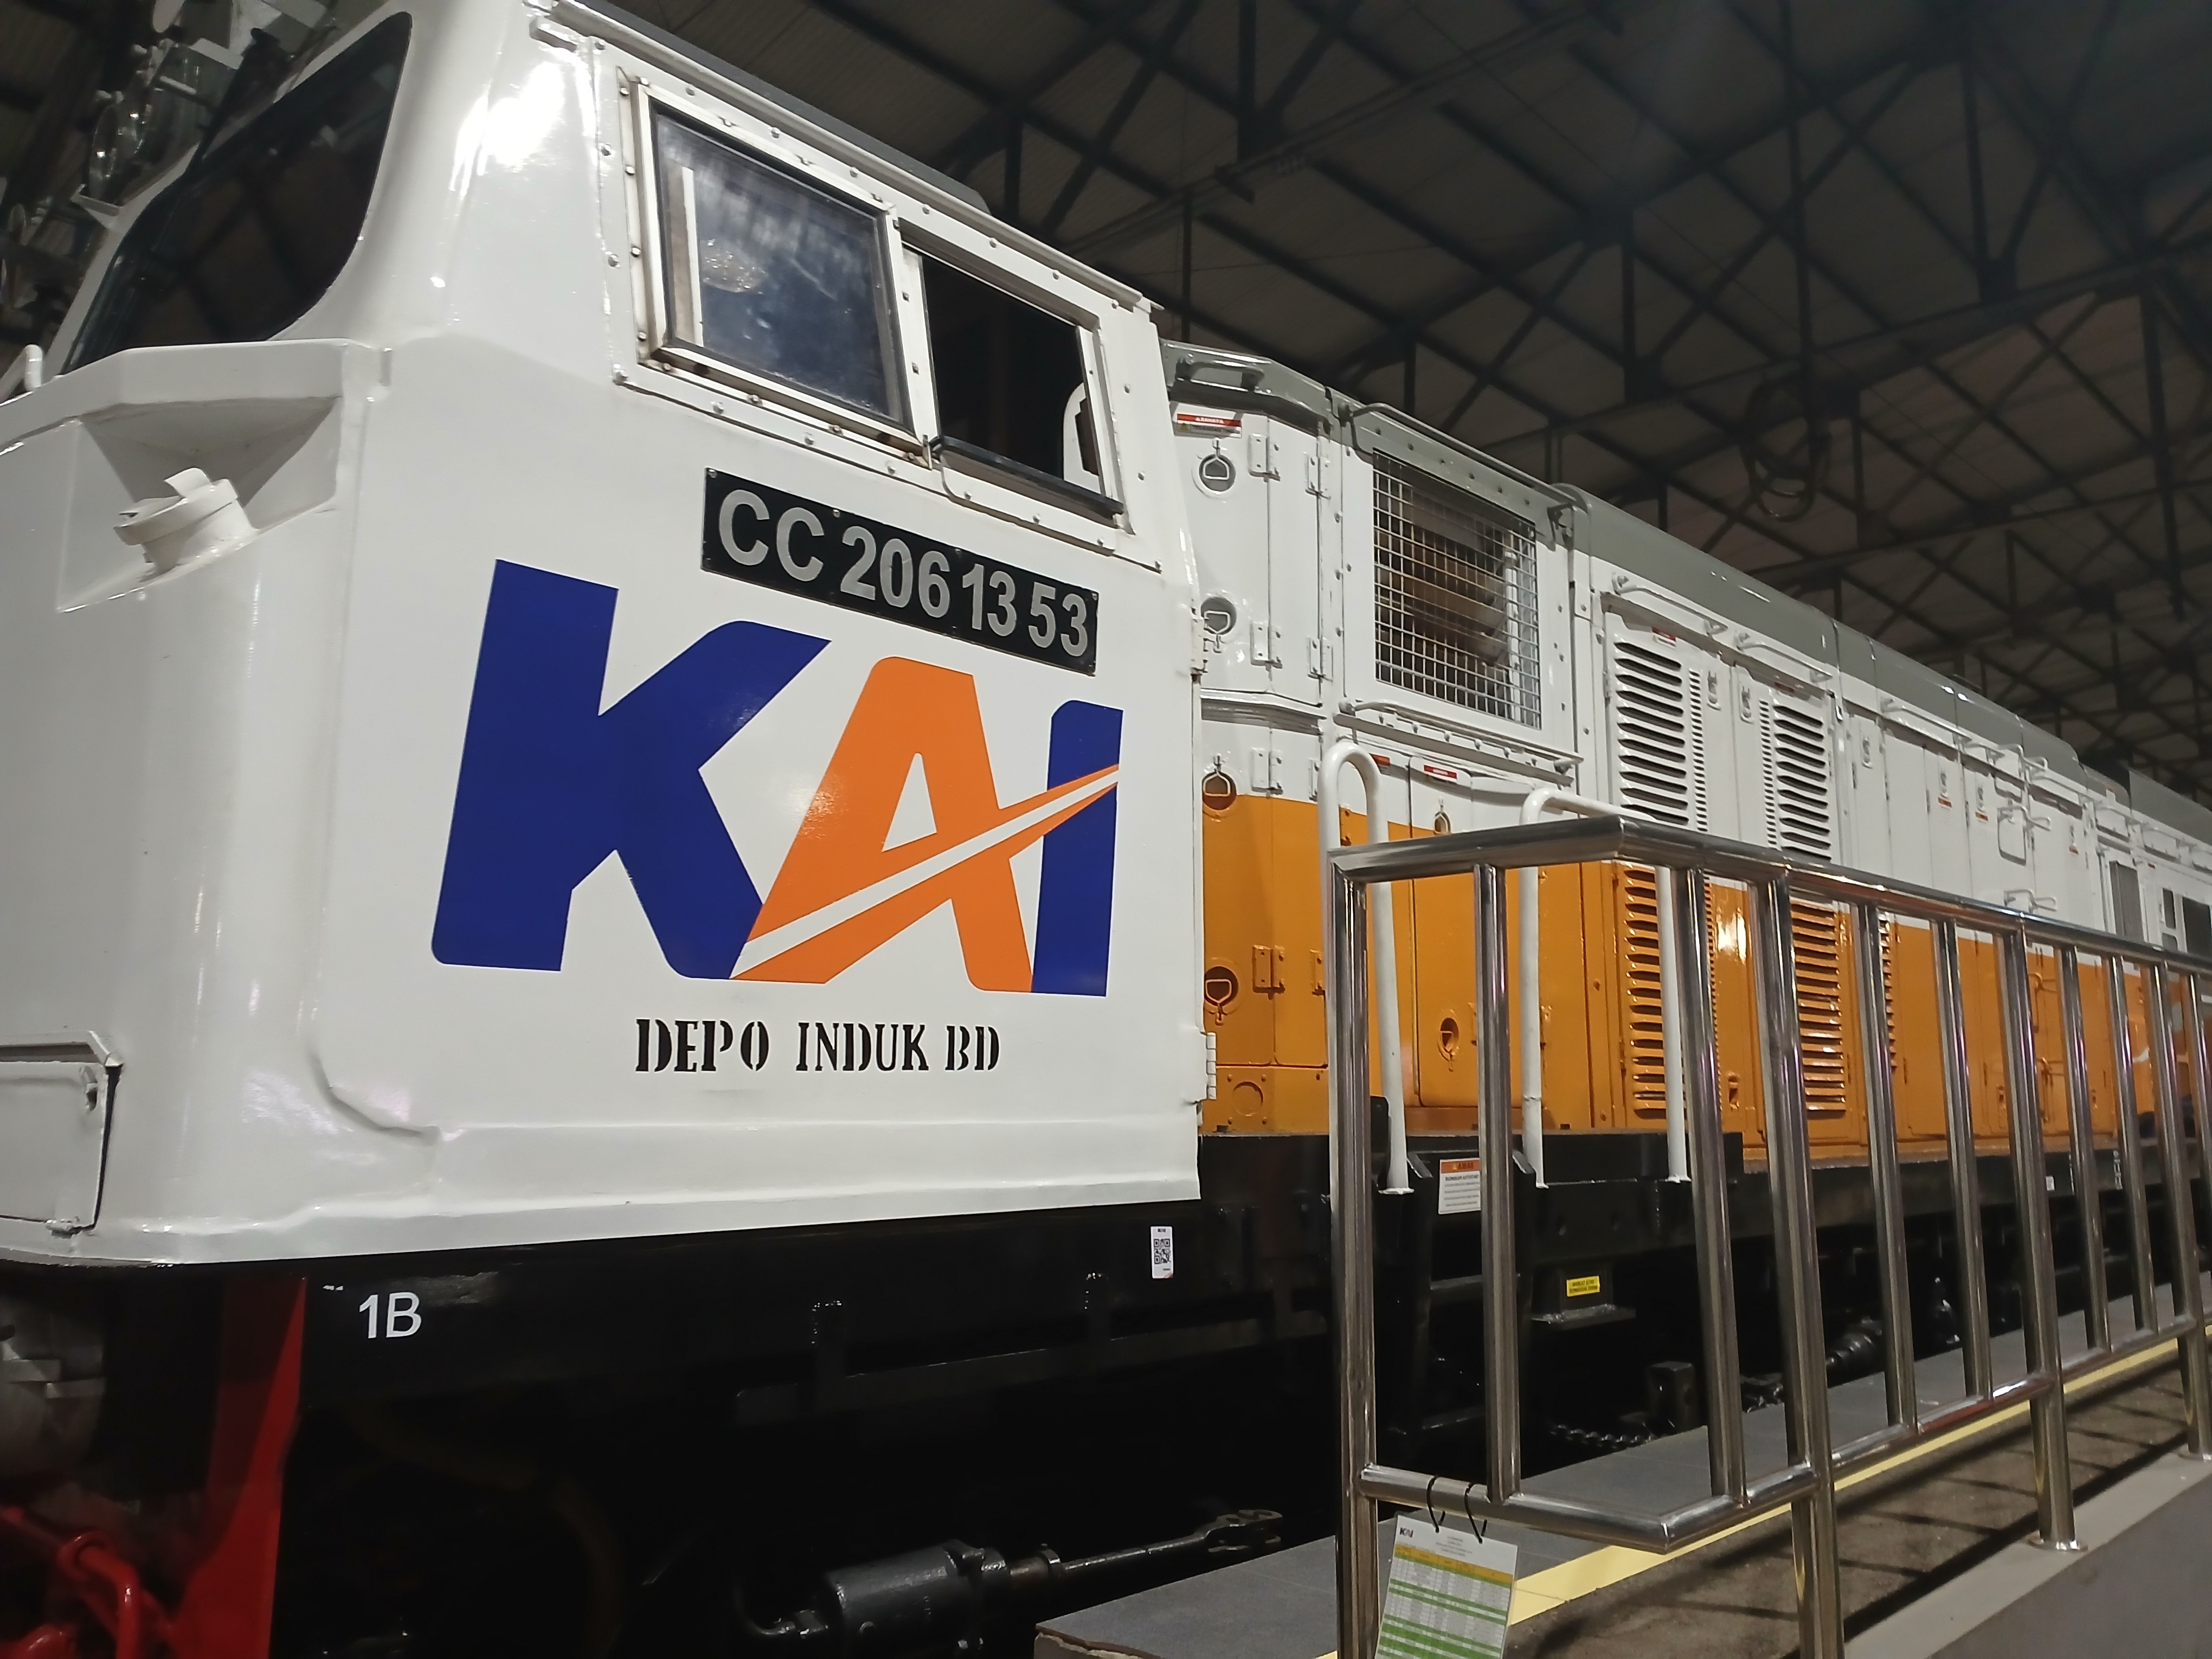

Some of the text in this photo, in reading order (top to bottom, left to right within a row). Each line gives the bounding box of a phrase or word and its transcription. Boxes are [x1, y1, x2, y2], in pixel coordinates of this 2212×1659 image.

[719, 490, 824, 582] CC
[840, 526, 950, 618] 206
[432, 558, 1123, 997] KAI
[635, 1019, 1000, 1072] DEPO INDUK BD
[359, 1291, 422, 1339] 1B
